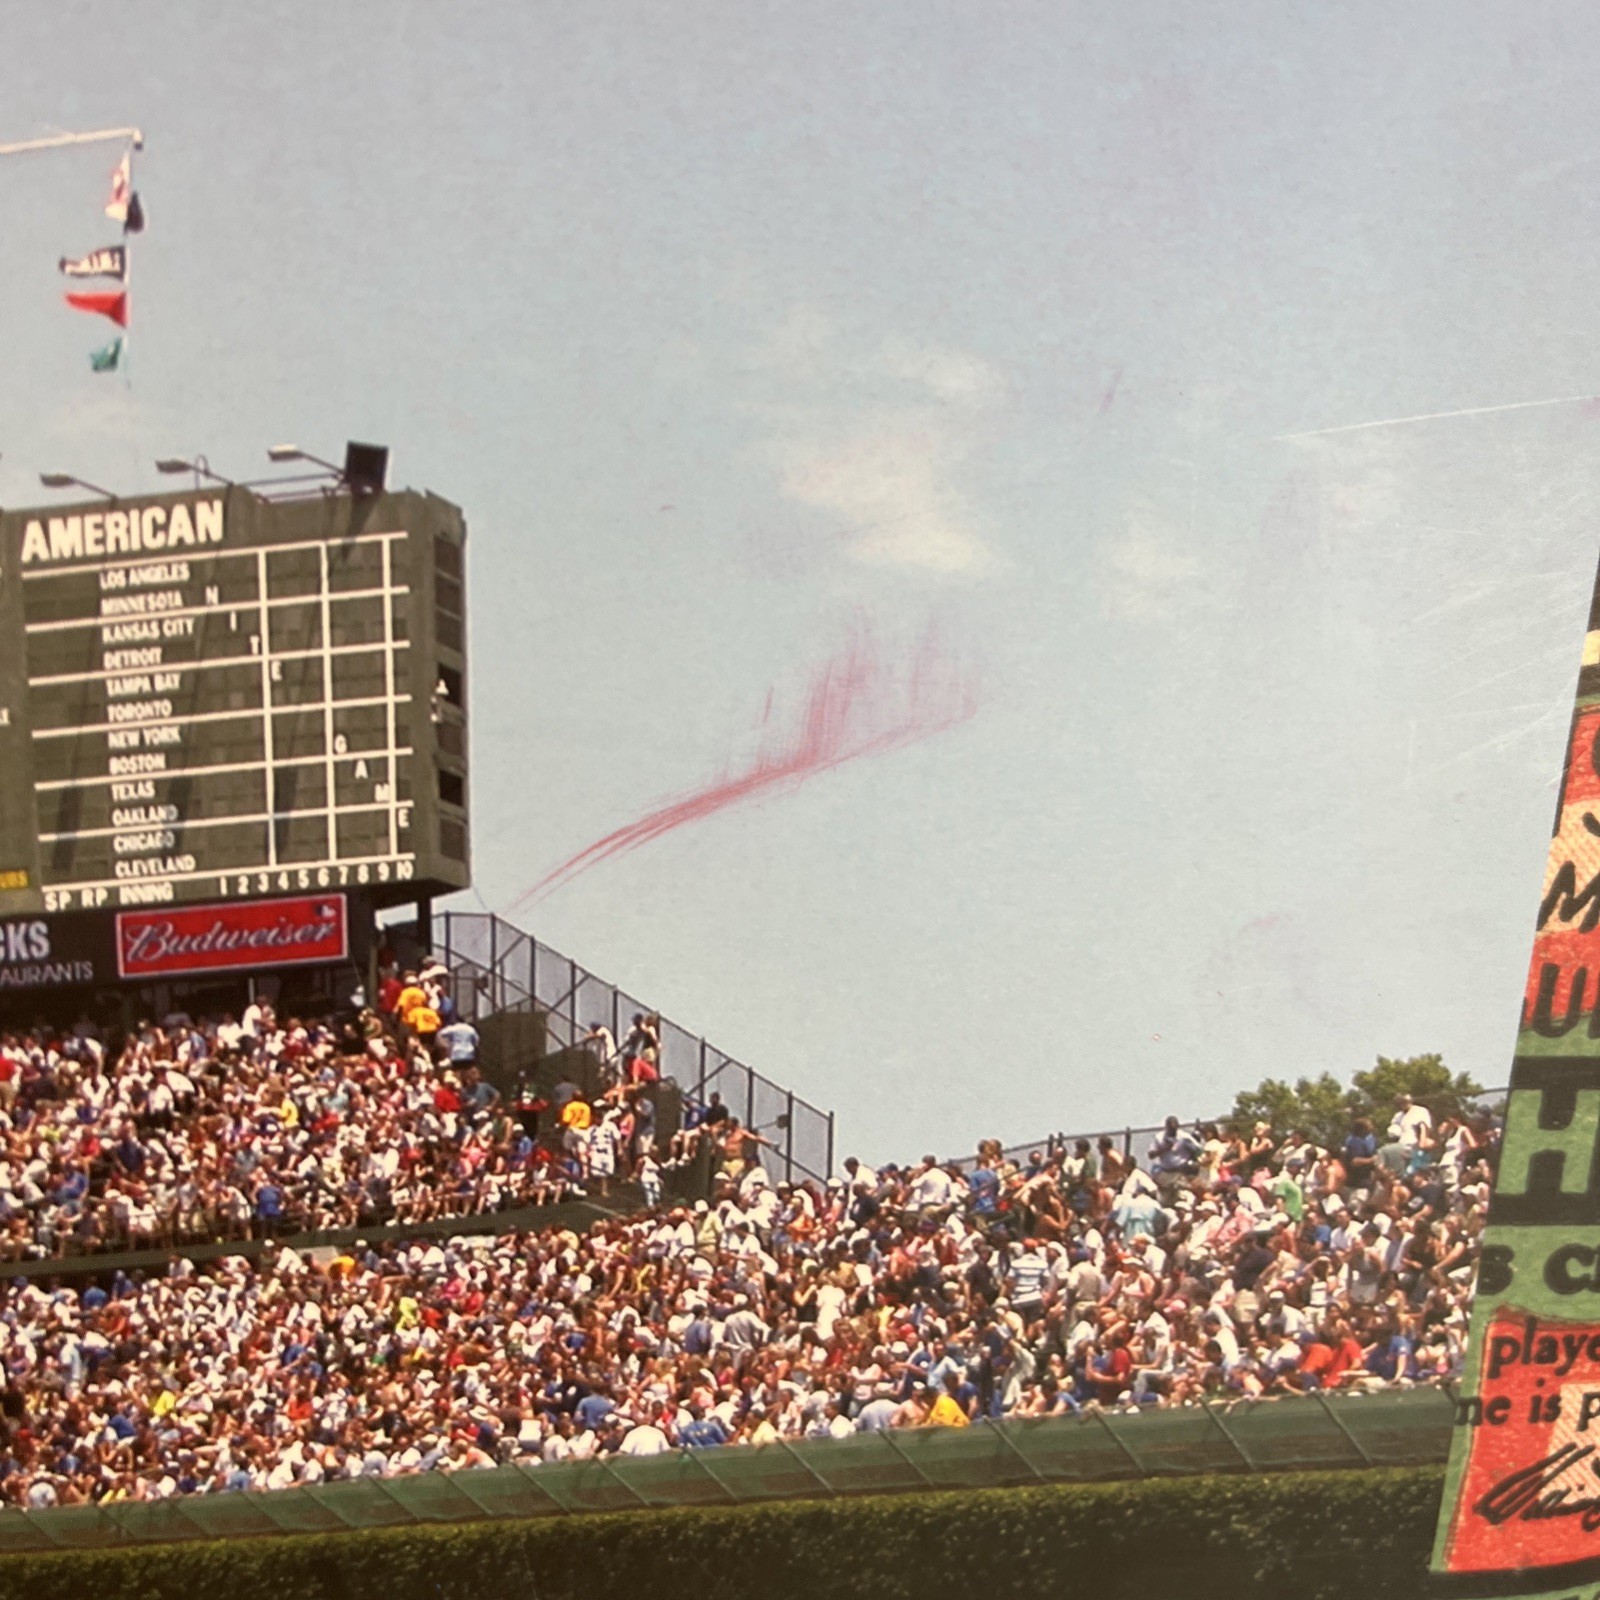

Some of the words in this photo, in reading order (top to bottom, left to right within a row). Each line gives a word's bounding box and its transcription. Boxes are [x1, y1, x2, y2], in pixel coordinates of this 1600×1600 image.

[21, 499, 223, 564] AMERICAN
[100, 568, 127, 591] LOS
[128, 561, 190, 587] ANGELES
[101, 590, 183, 615] MINNESOTA
[103, 620, 160, 644] KANSAS
[162, 616, 195, 638] CITY
[104, 646, 162, 670] DETROIT
[106, 674, 152, 697] TAMPA
[153, 672, 181, 693] BAY
[107, 698, 173, 722] TORONTO
[108, 730, 140, 750] NEW
[142, 725, 182, 746] YORK
[109, 752, 166, 775] BOSTON
[112, 780, 156, 802] TEXAS
[112, 803, 178, 826] OAKLAND
[113, 830, 176, 854] CHICAGO
[115, 853, 197, 879] CLEVELAND
[45, 890, 72, 913] SP
[81, 887, 109, 909] RP
[119, 881, 174, 906] INNING
[219, 875, 228, 896] 1
[237, 873, 250, 896] 2
[257, 871, 270, 893] 3
[277, 870, 290, 891] 4
[298, 868, 310, 889] 5
[317, 866, 330, 887] 6
[338, 865, 349, 885] 7
[357, 863, 370, 884] 8
[377, 861, 390, 882] 9
[396, 860, 415, 881] 10
[124, 915, 337, 963] Budweiser
[1526, 1377, 1562, 1424] is
